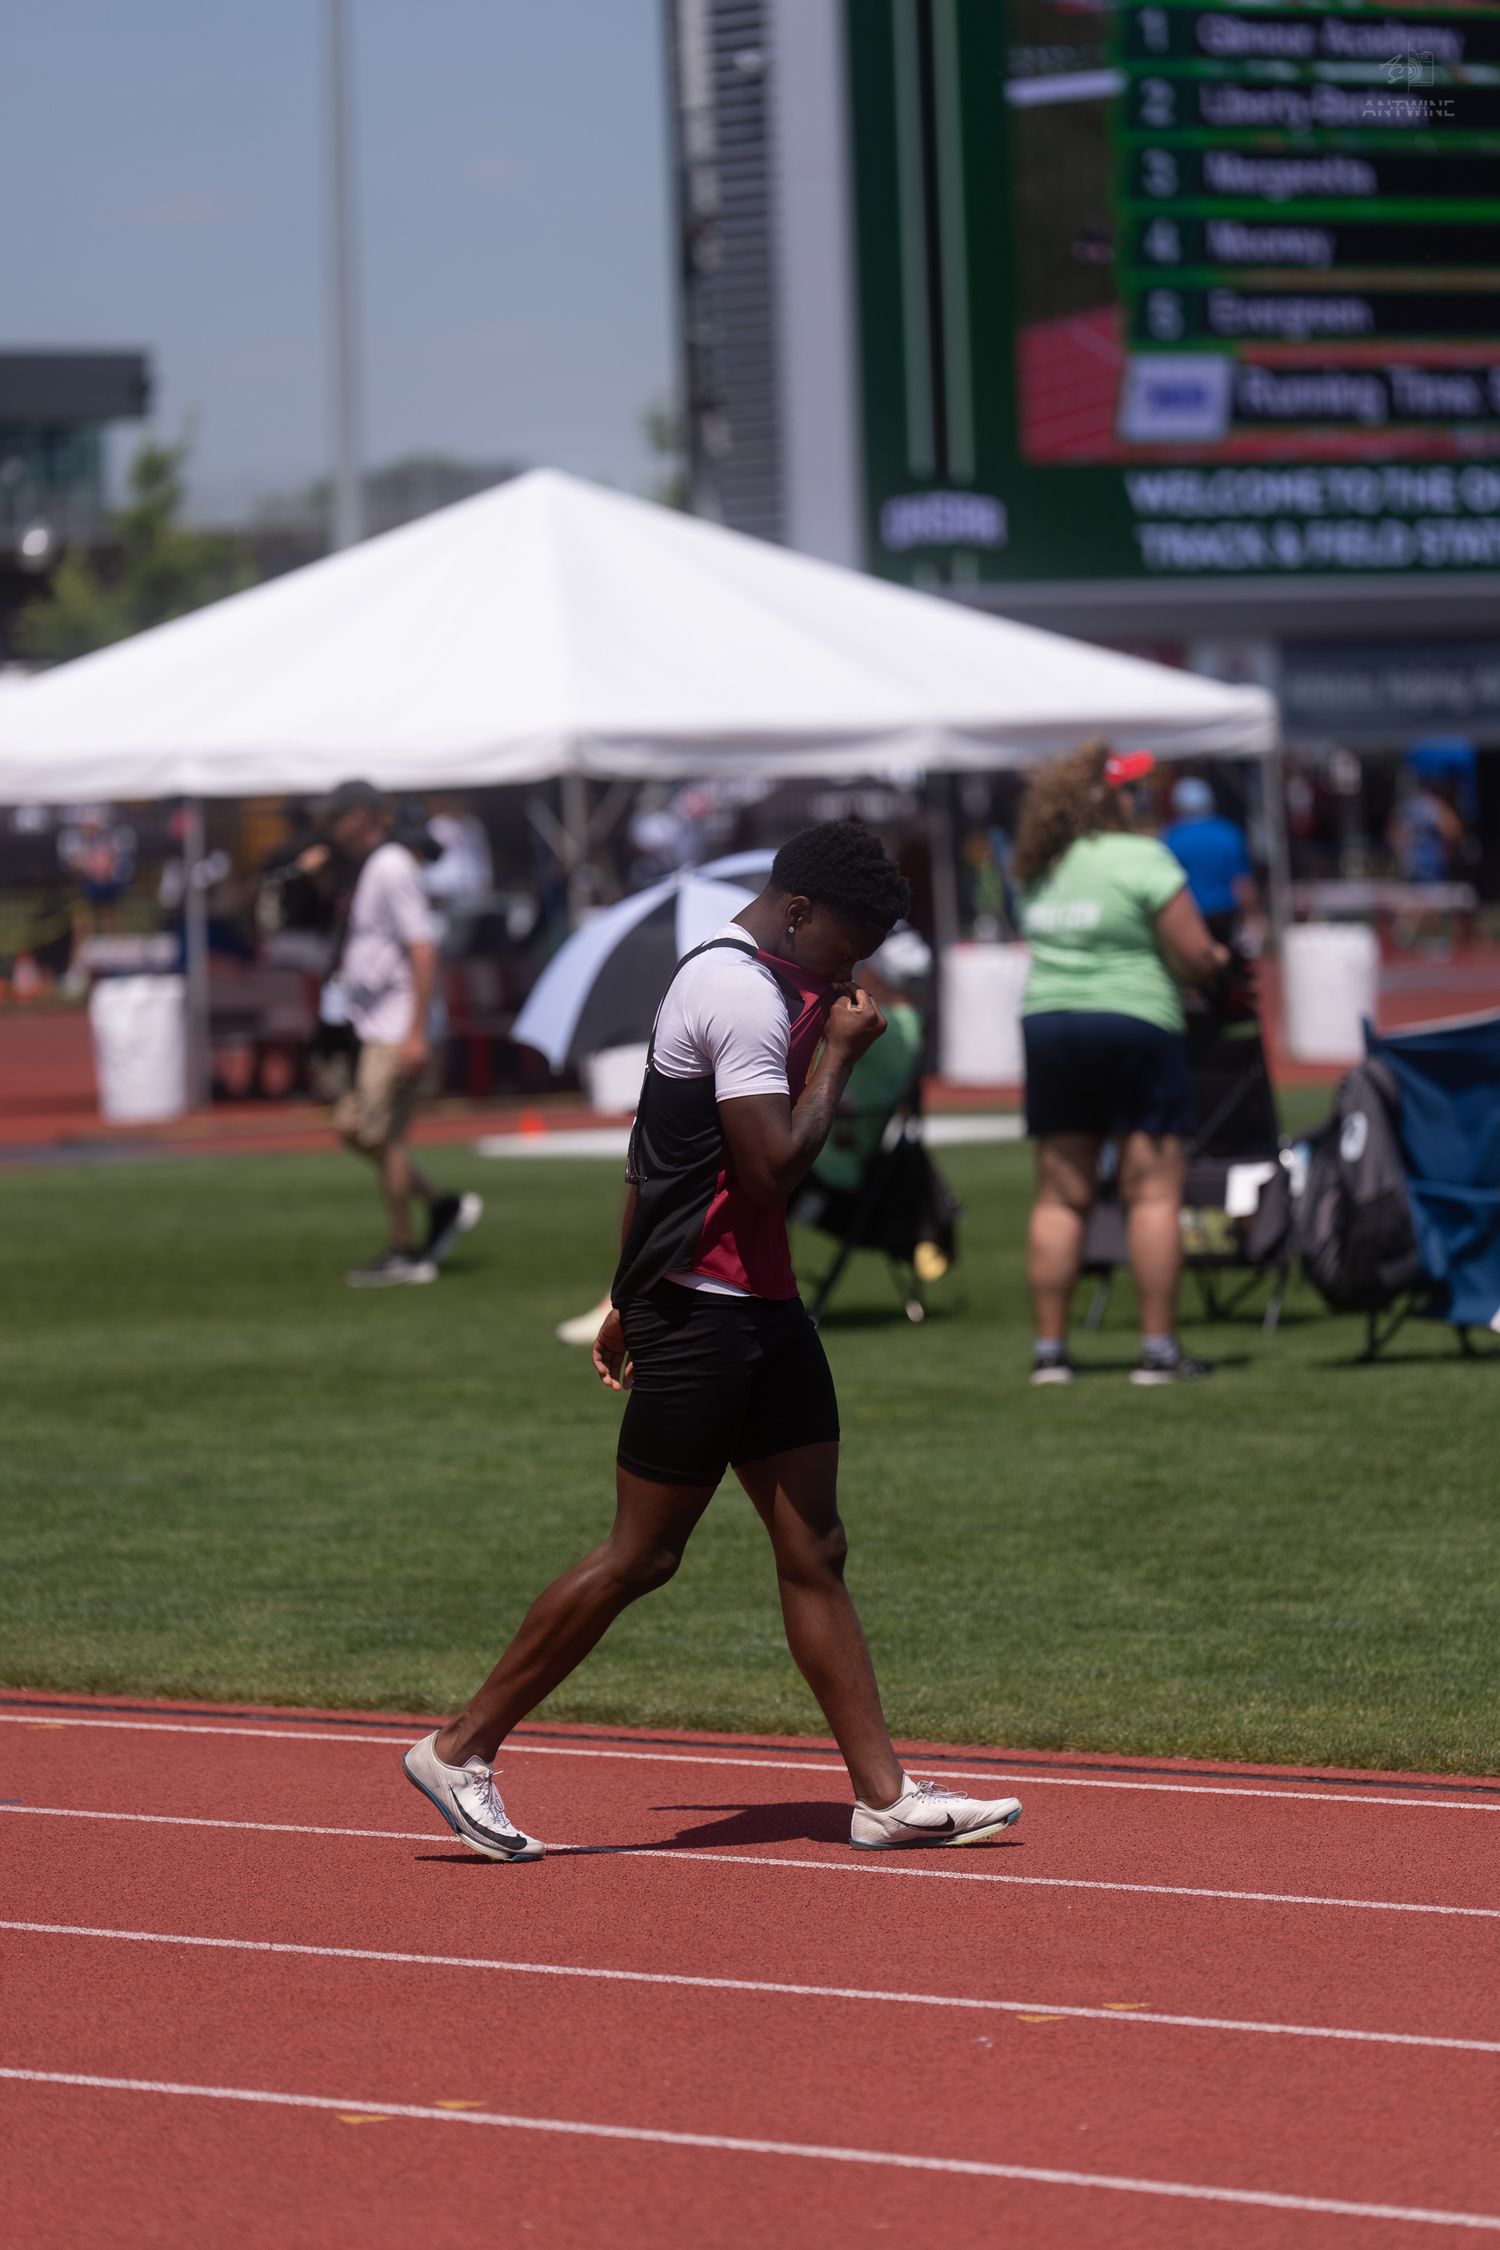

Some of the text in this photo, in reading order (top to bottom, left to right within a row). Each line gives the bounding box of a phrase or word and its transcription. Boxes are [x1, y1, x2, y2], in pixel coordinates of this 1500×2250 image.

[1141, 9, 1167, 48] 1
[1143, 79, 1174, 126] 2
[1143, 151, 1176, 197] 3
[1145, 219, 1179, 265] 4
[1149, 290, 1183, 340] 5
[1240, 368, 1387, 423] Running
[1127, 468, 1326, 515] WELCOME
[1325, 467, 1382, 514] TO
[1380, 467, 1457, 514] THE
[1138, 522, 1269, 569] TRACK
[1272, 521, 1304, 568] &
[1304, 520, 1413, 567] FIELD
